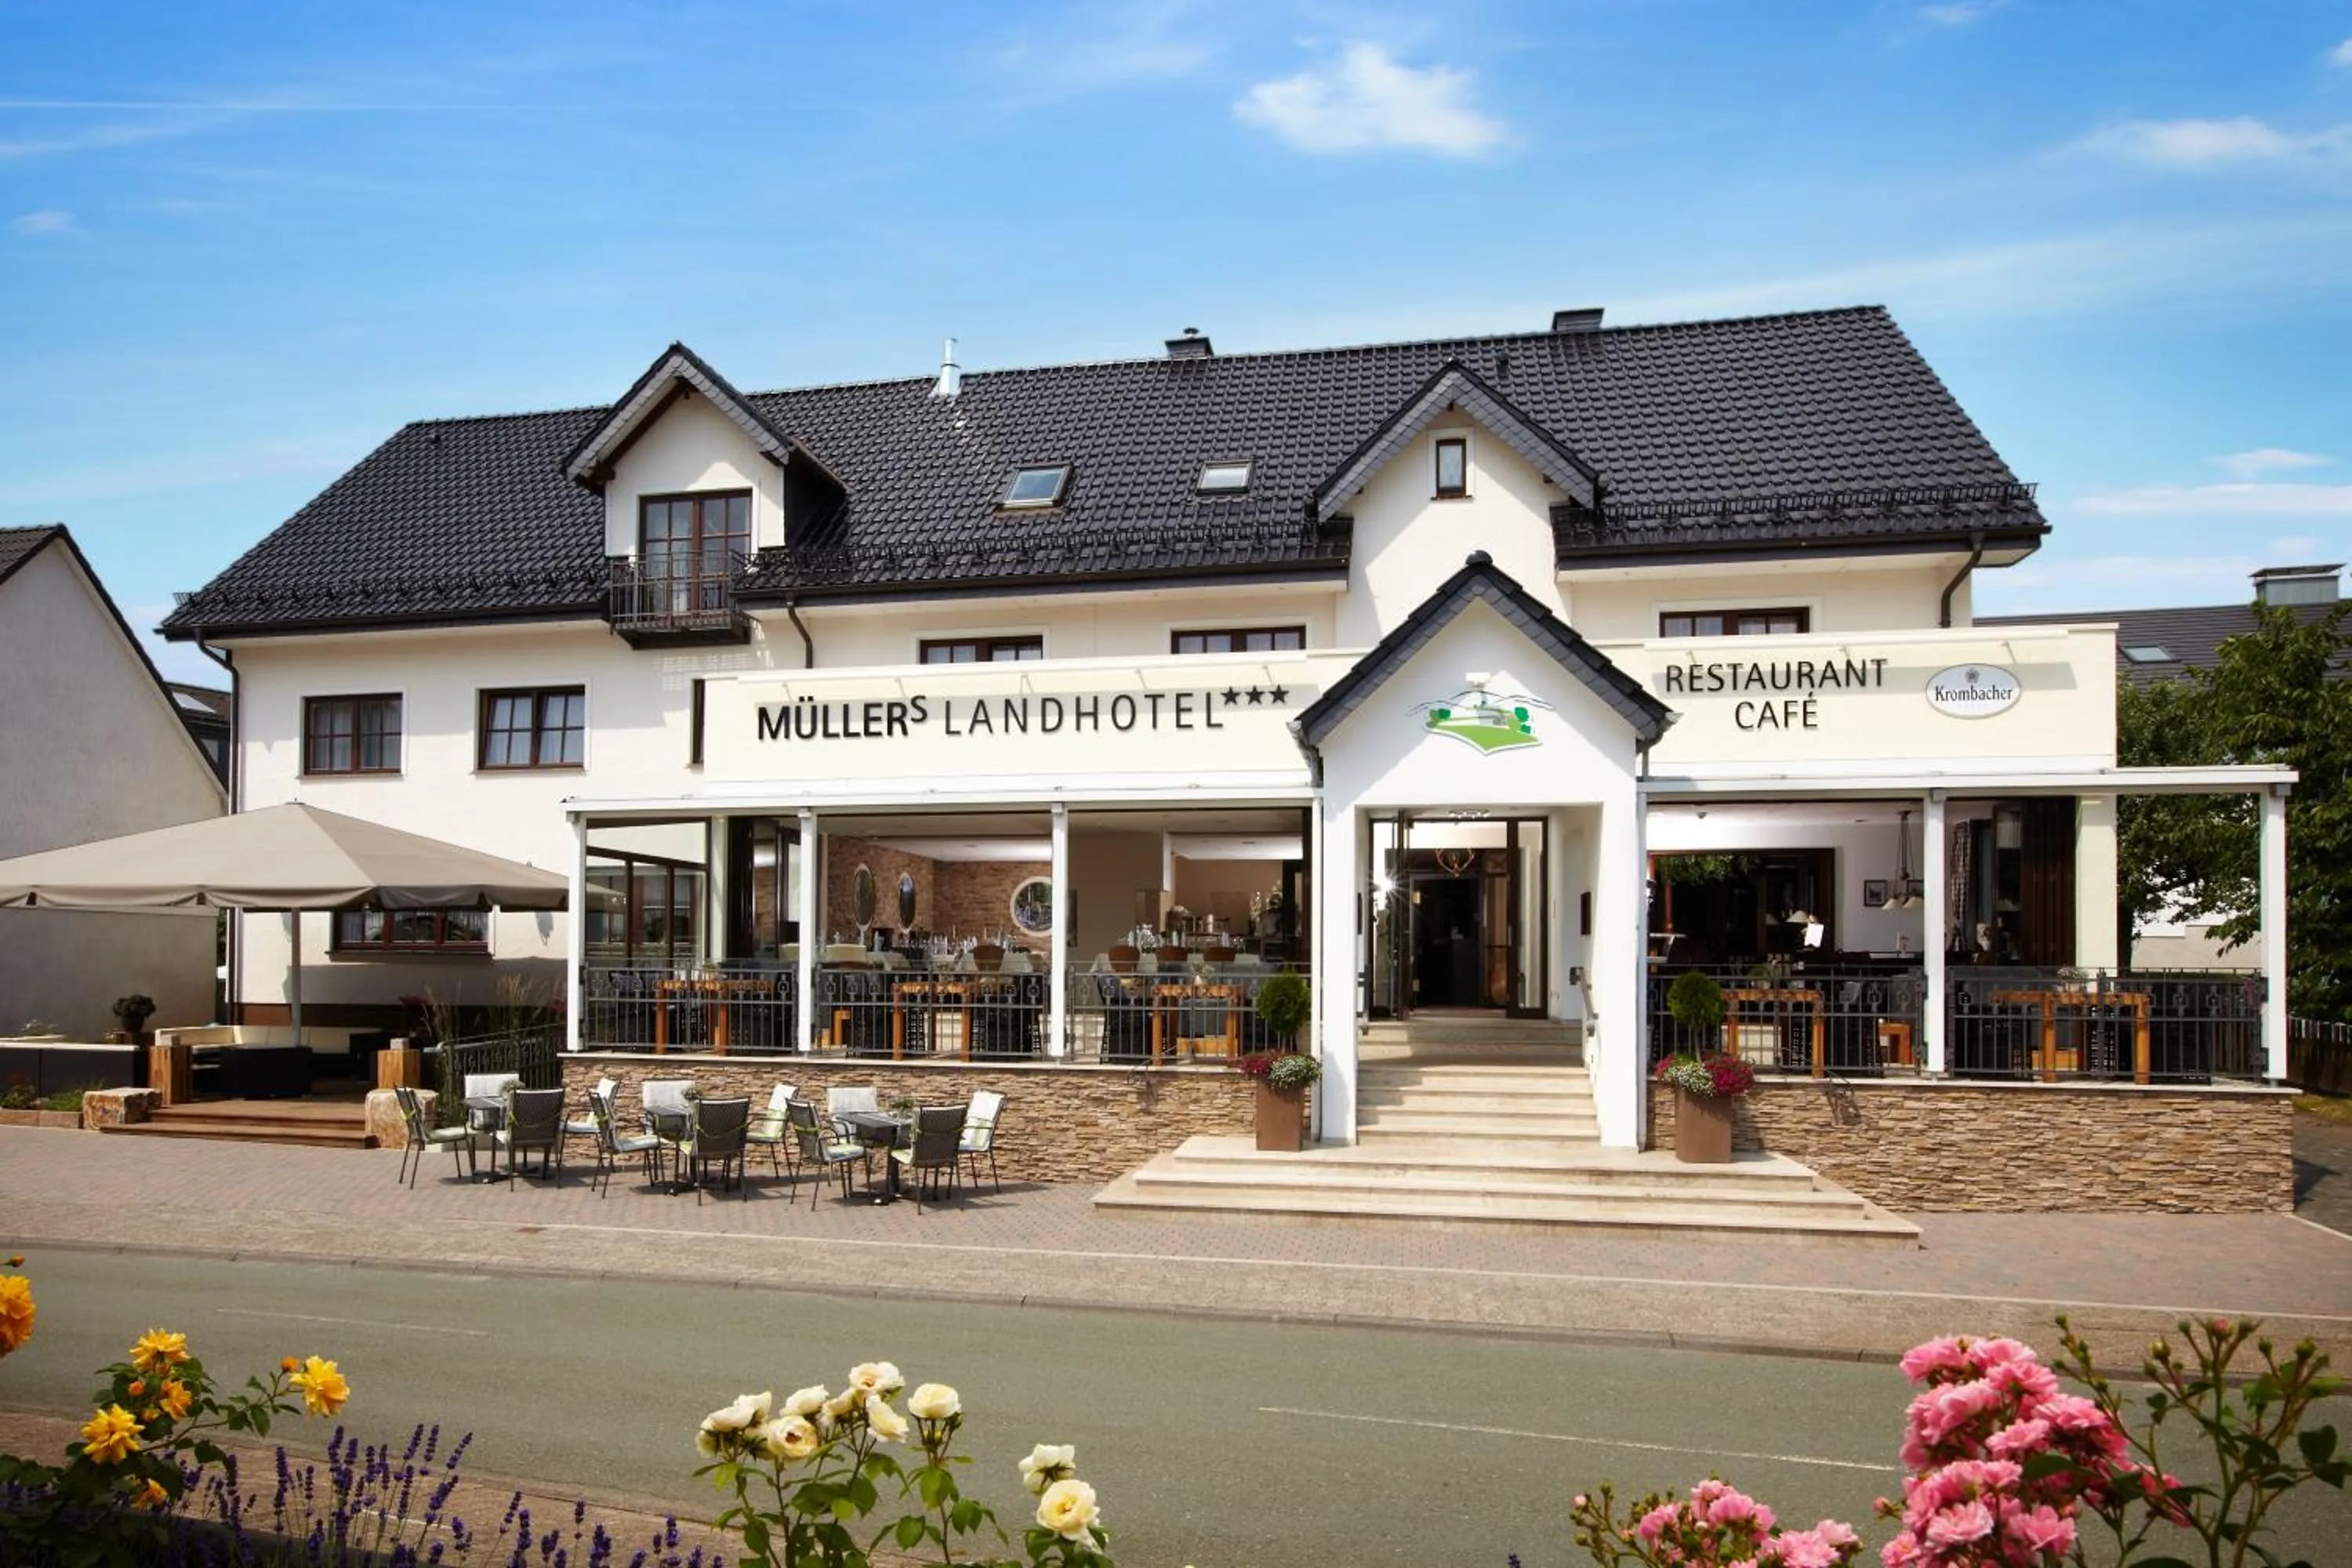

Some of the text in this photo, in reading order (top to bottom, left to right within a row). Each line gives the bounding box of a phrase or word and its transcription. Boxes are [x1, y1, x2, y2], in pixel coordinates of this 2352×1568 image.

[1666, 659, 1888, 692] RESTAURANT
[1935, 684, 2013, 702] Krombacher
[758, 691, 1224, 740] MÜLLERS LANDHOTEL
[1733, 691, 1818, 729] CAFÉ
